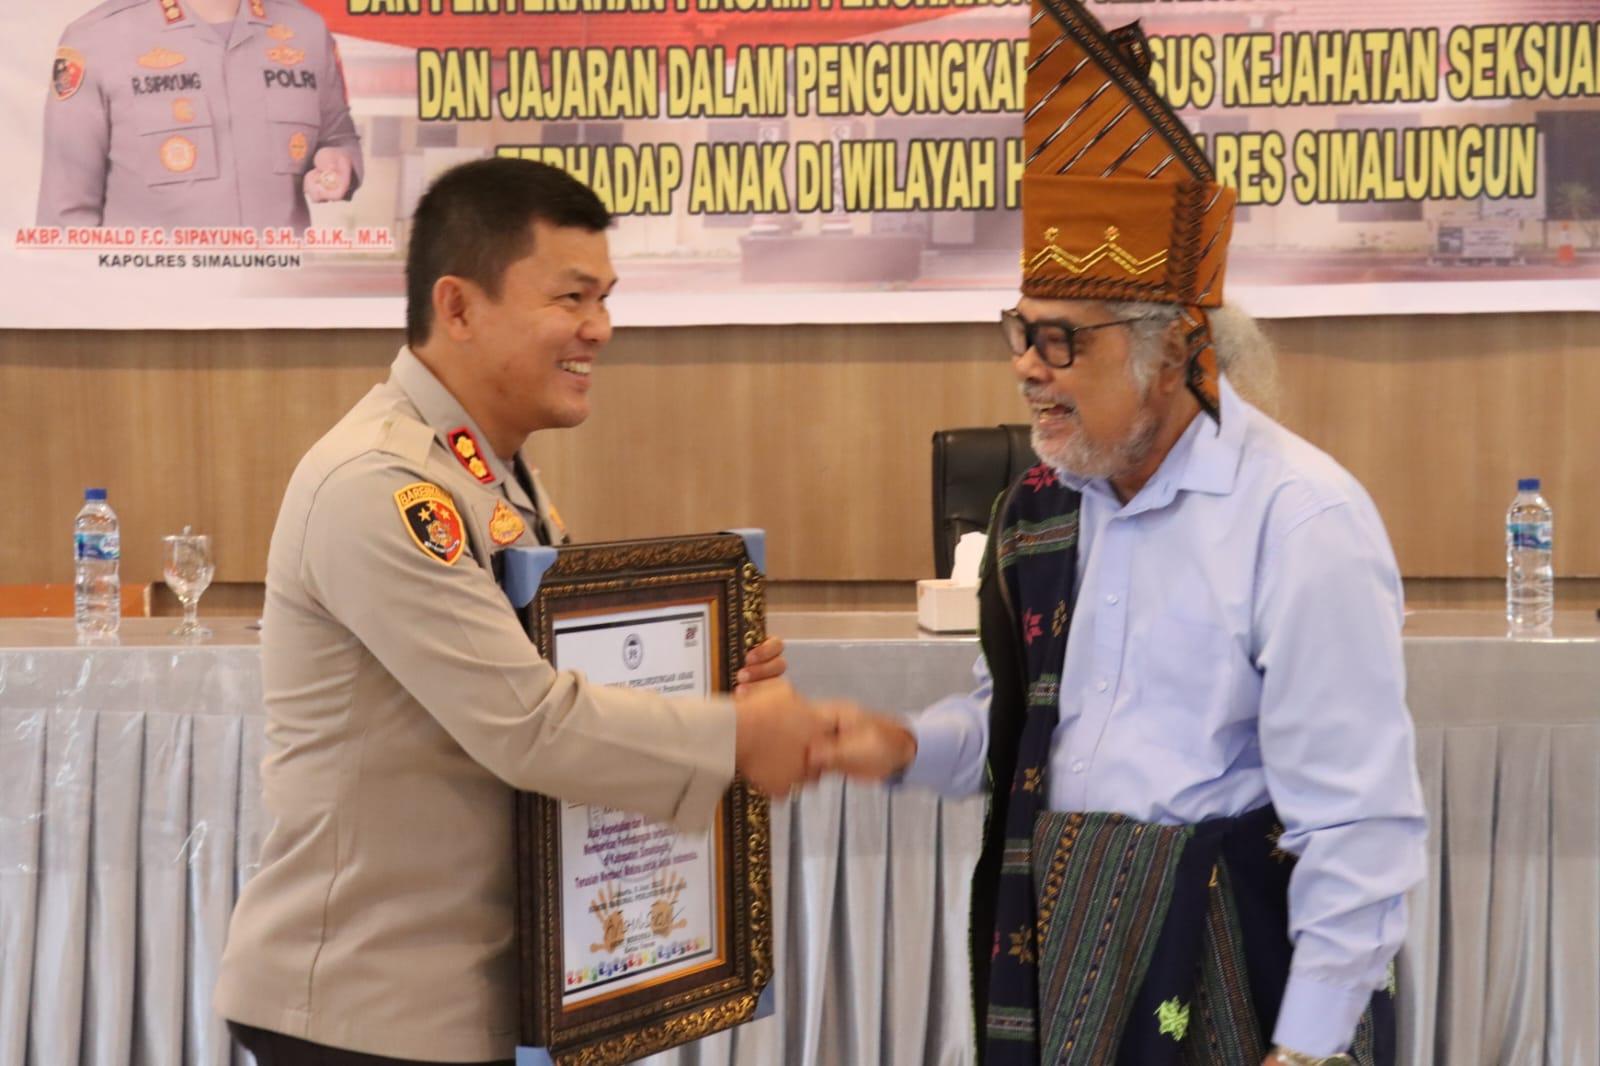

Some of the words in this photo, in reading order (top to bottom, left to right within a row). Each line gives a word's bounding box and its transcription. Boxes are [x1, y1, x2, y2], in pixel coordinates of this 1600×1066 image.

[264, 69, 317, 91] POLRI
[417, 48, 492, 120] DAN
[499, 46, 659, 120] JAJARAN
[667, 45, 788, 118] DALAM
[1223, 27, 1438, 107] KEJAHATAN
[495, 142, 684, 215] HADAP
[688, 142, 789, 214] ANAK
[796, 139, 833, 212] DI
[840, 137, 998, 211] WILAYAH
[1291, 124, 1537, 205] SIMALUNGUN
[16, 229, 63, 244] AKBP.
[68, 229, 135, 244] RONALD
[141, 229, 168, 244] F.C.
[174, 228, 259, 249] SIPAYUNG,
[358, 229, 393, 245] M.H.
[98, 254, 187, 268] KAPOLRES
[192, 254, 301, 267] SIMALUNGUN
